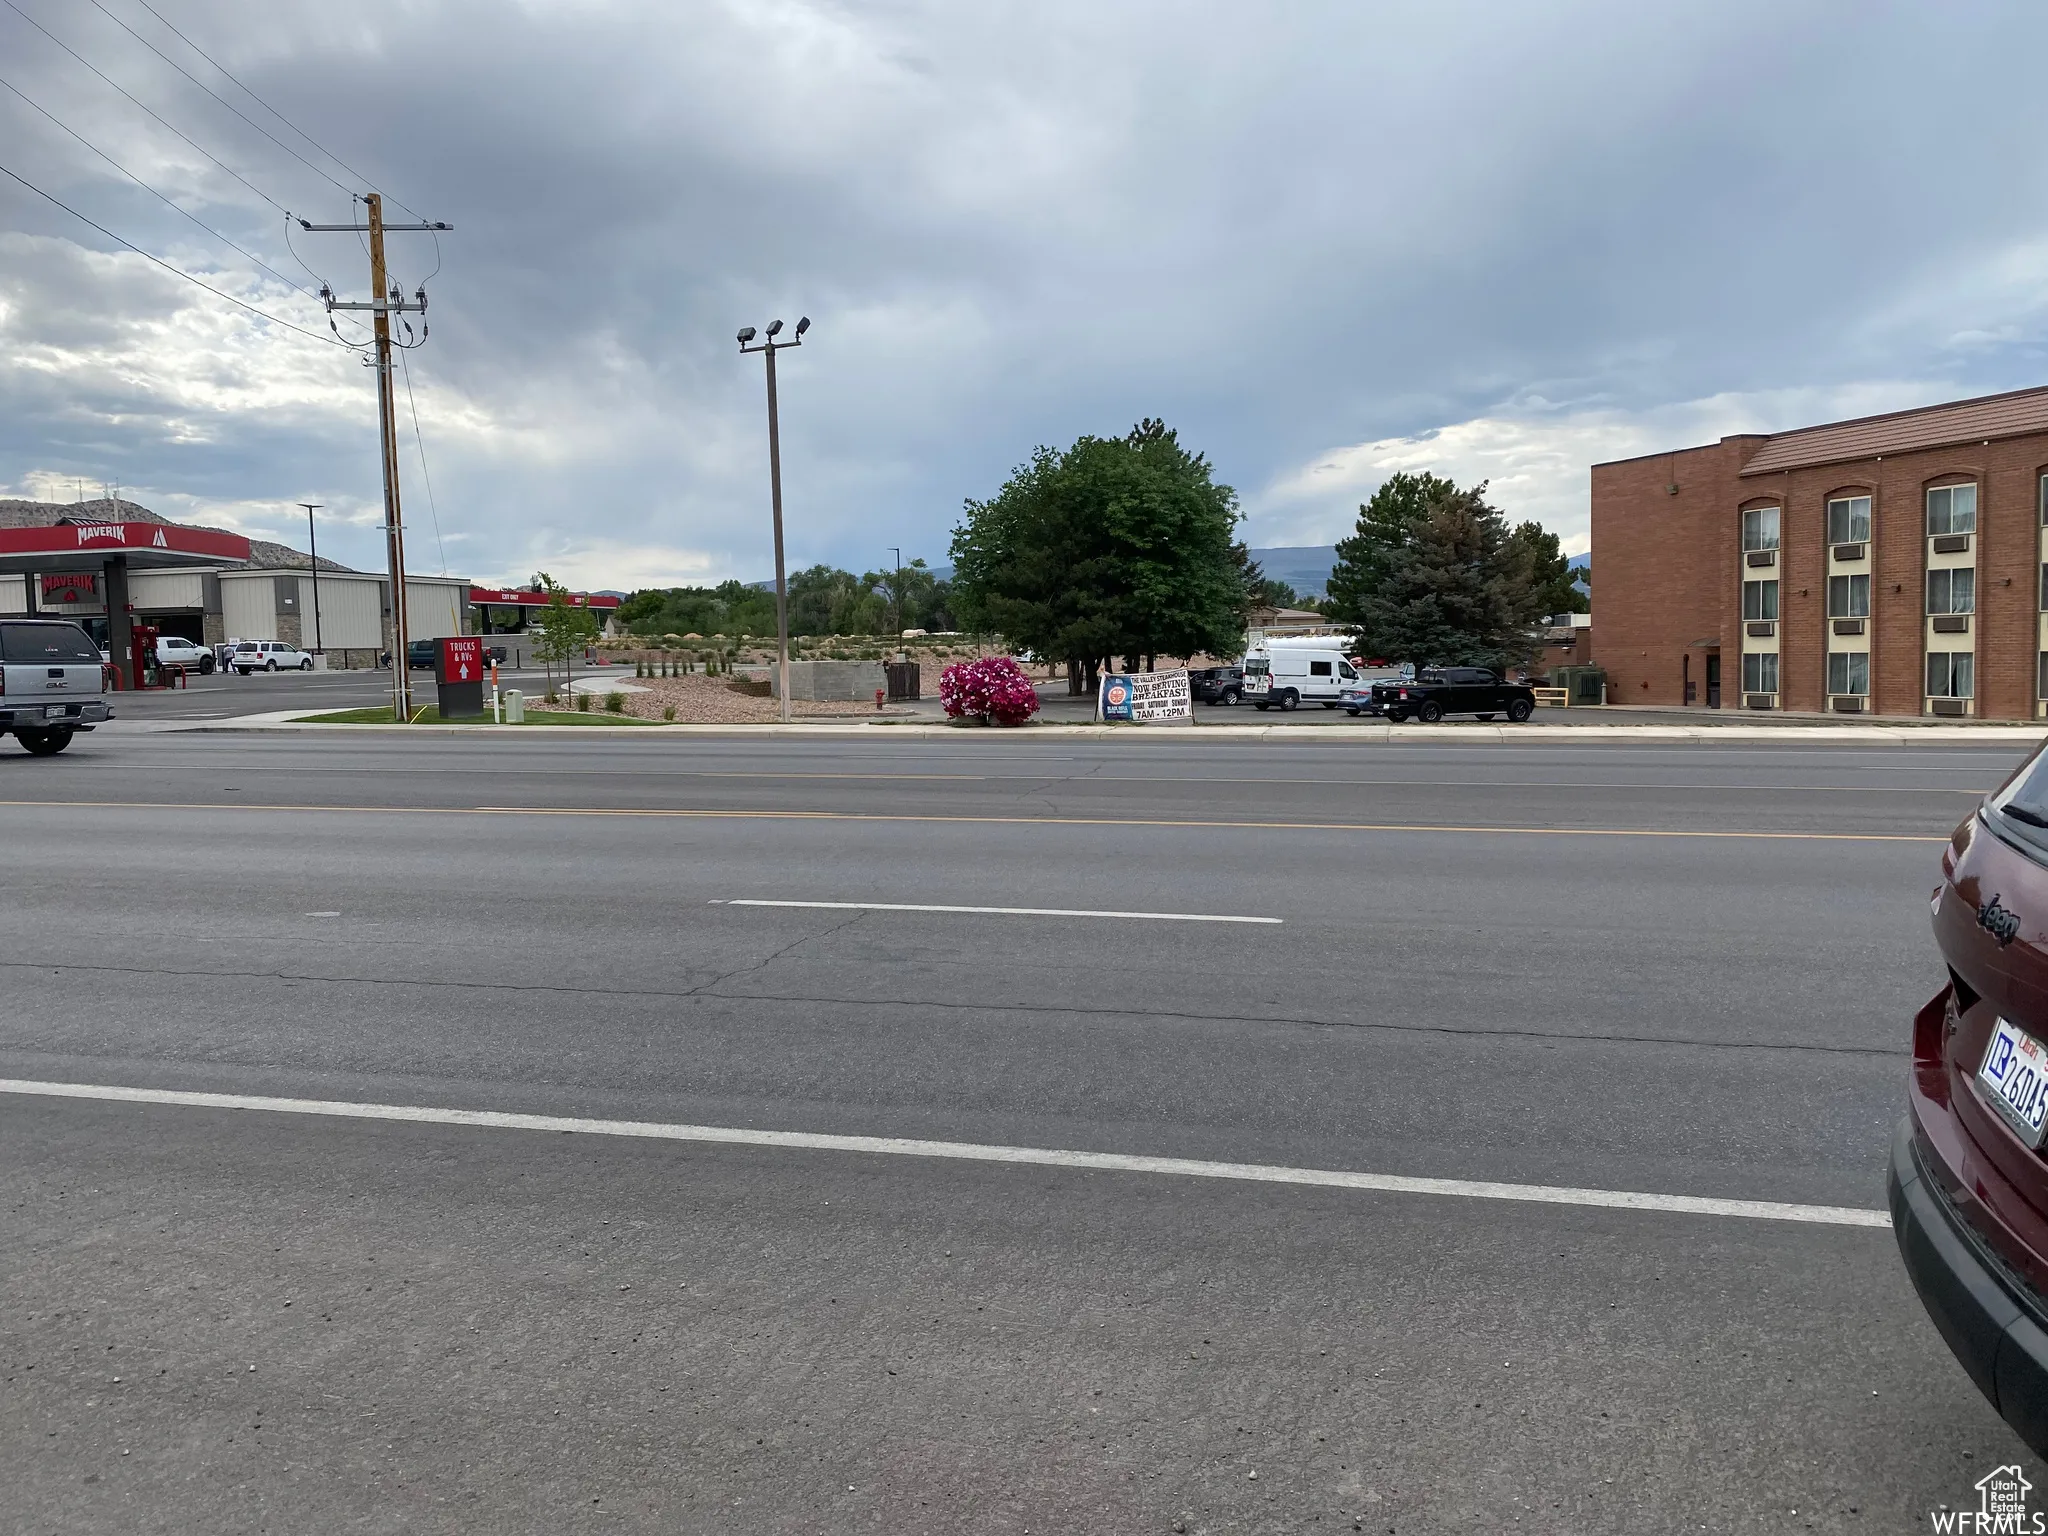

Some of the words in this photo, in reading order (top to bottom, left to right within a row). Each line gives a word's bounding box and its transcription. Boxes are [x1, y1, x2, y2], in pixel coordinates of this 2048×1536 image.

[77, 525, 126, 546] MAVERIK
[43, 575, 96, 596] MAVERIK
[450, 642, 476, 651] TRUCKS
[454, 652, 460, 662] &
[461, 652, 472, 662] RVs
[1156, 671, 1186, 682] STEAKHOUSE
[1133, 684, 1150, 693] NOW
[1152, 679, 1186, 690] SERVING
[1132, 688, 1187, 700] BREAKFAST
[1136, 710, 1154, 718] 7AM
[1162, 708, 1184, 716] 12PM
[1977, 893, 2021, 946] Jeep
[2018, 1033, 2038, 1060] Utah
